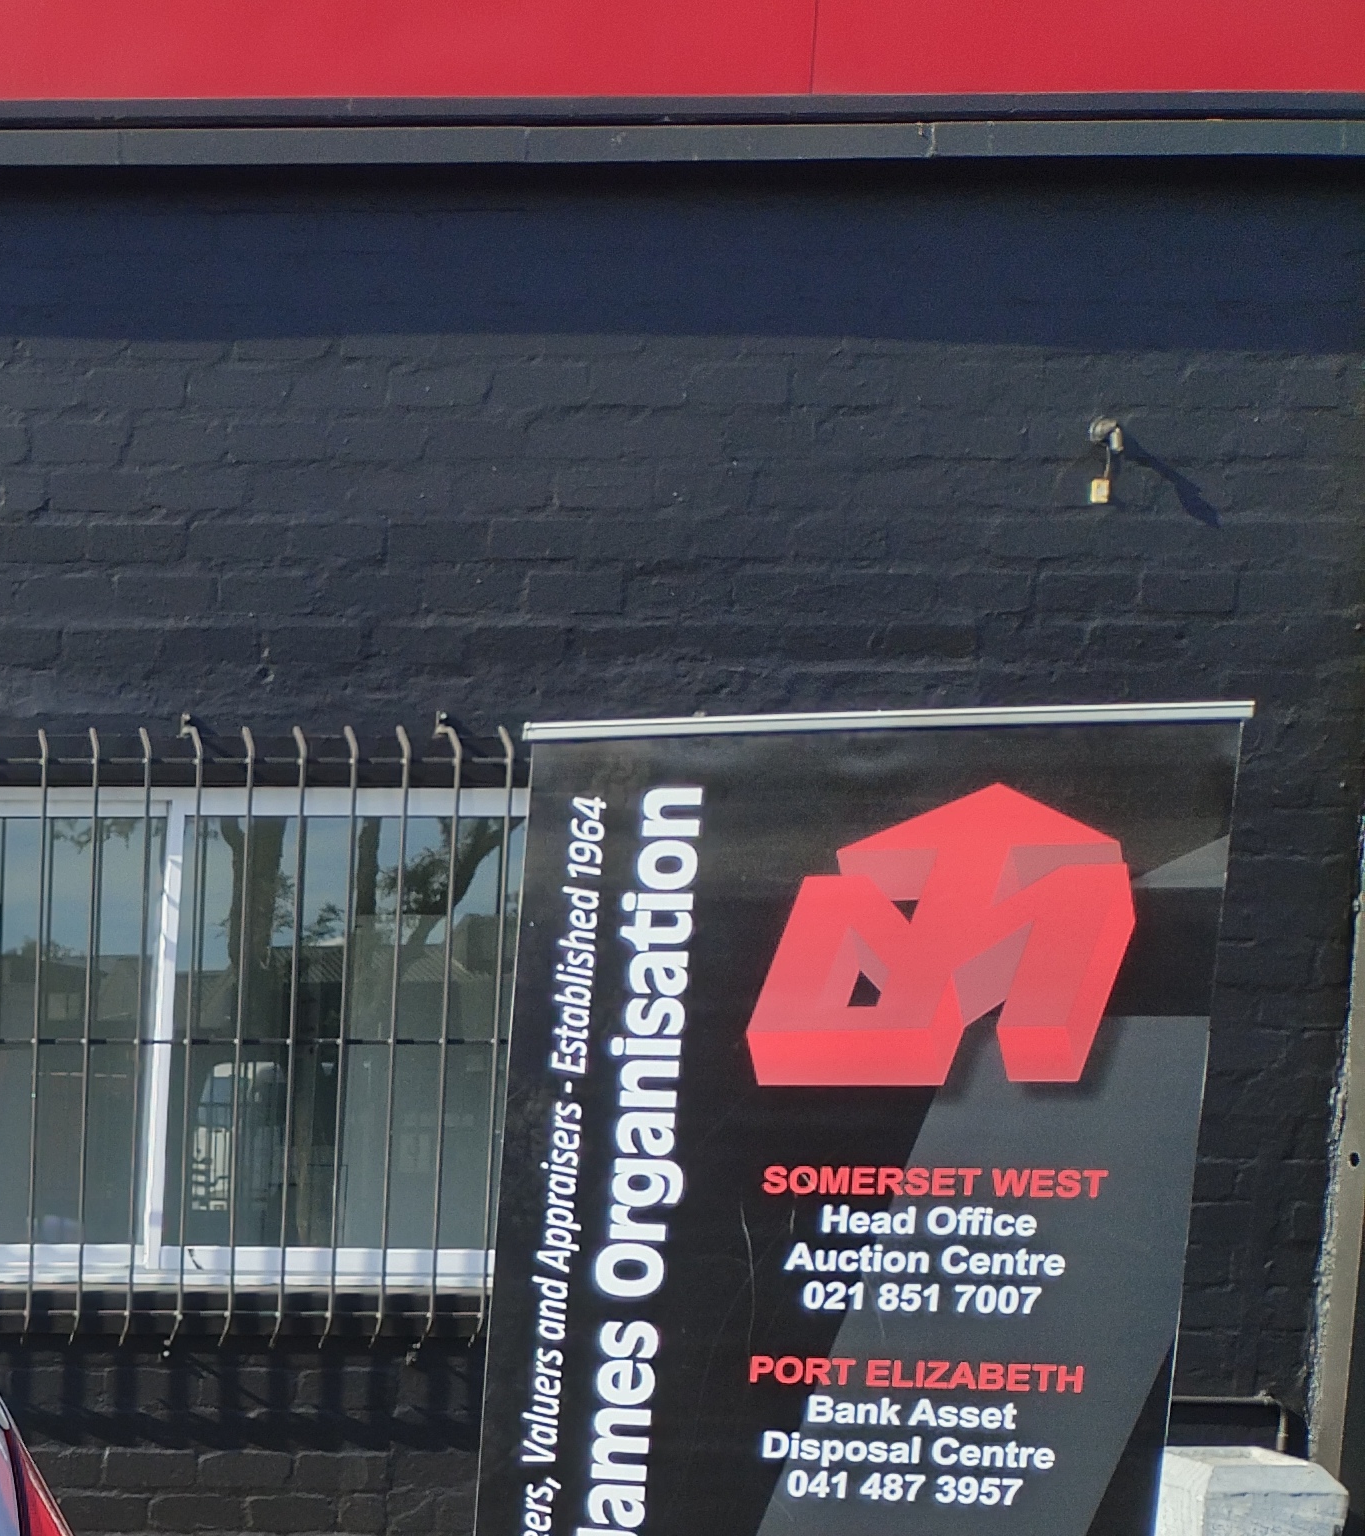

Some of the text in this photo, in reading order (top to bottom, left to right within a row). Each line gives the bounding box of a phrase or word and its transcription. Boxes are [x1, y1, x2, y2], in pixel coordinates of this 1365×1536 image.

[567, 796, 607, 878] 1964
[550, 885, 600, 1074] Established
[587, 787, 704, 1298] Organisation
[536, 1101, 583, 1274] Appraisers
[762, 1165, 1109, 1199] SOMERSET WEST
[820, 1204, 1038, 1237] Head Office
[783, 1242, 1066, 1277] Auction Centre
[531, 1275, 569, 1341] and
[802, 1280, 1043, 1315] 021 851 7007
[749, 1355, 1084, 1393] PORT ELIZABETH
[521, 1347, 564, 1463] Valuers
[806, 1394, 1018, 1430] Bank Asset
[762, 1430, 1056, 1470] Disposal Centre
[786, 1469, 1024, 1506] 041 487 3957
